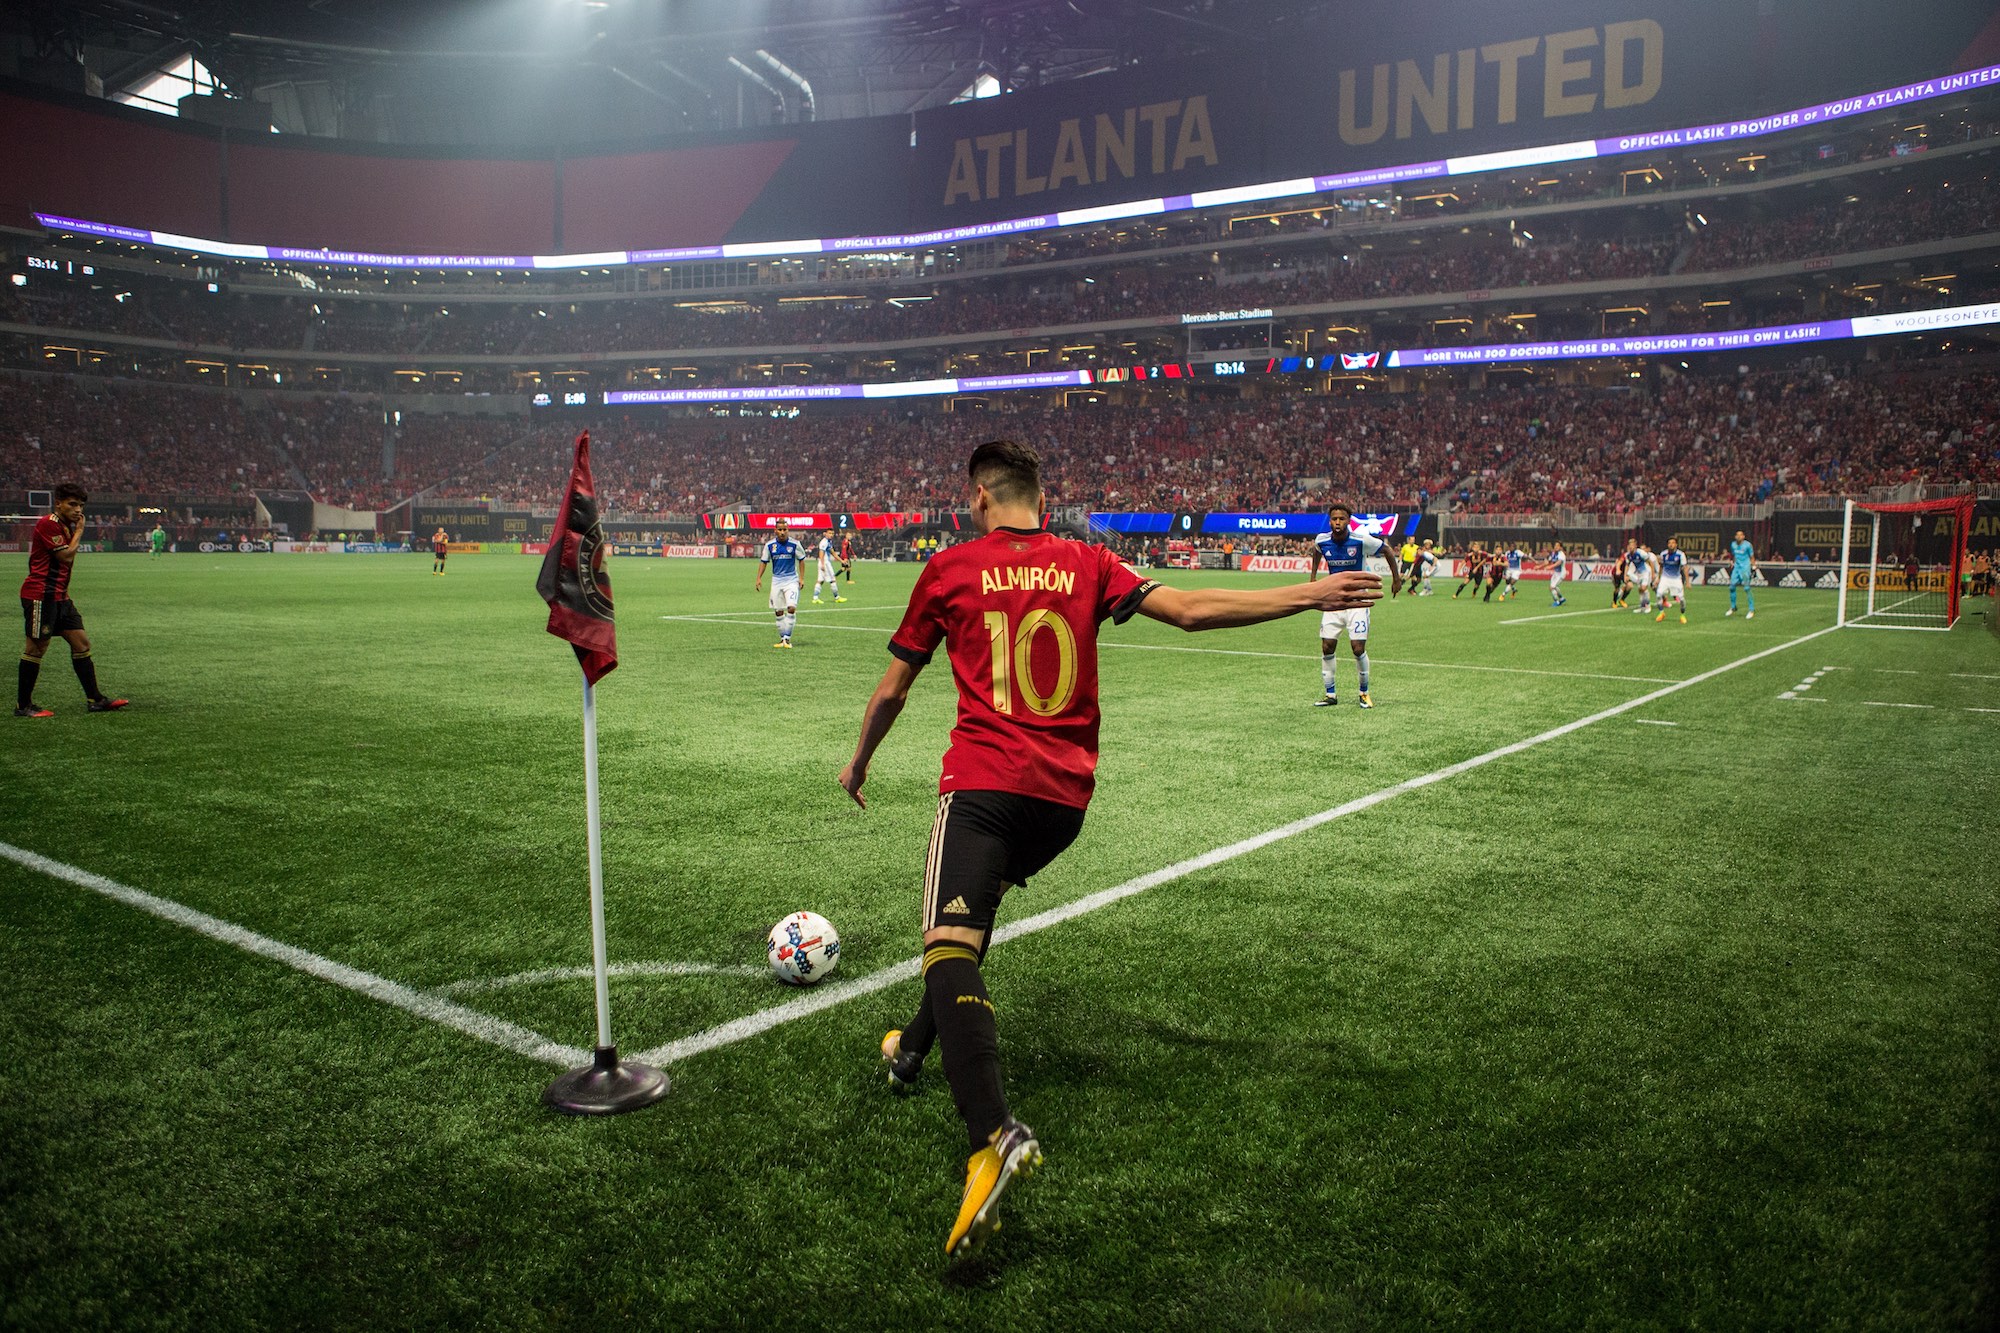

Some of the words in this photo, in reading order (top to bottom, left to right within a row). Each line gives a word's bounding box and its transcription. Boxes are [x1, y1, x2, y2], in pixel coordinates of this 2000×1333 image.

[1338, 19, 1664, 145] UNITED
[1620, 133, 1681, 150] OFFICIAL
[1686, 126, 1725, 142] LASIK
[1730, 113, 1798, 136] PROVIDER
[1824, 99, 1862, 117] YOUR
[1866, 84, 1934, 108] ATLANTA
[1940, 68, 2000, 91] UNITED
[944, 95, 1218, 205] ATLANTA
[834, 238, 874, 248] OFFICIAL
[876, 237, 901, 246] LASIK
[904, 232, 942, 244] PROVIDER
[955, 228, 976, 237] YOUR
[977, 223, 1013, 234] ATLANTA
[1015, 218, 1046, 229] UNITED
[27, 256, 59, 270] 53:14
[282, 249, 326, 260] OFFICIAL
[329, 253, 355, 262] LASIK
[358, 254, 403, 264] PROVIDER
[418, 257, 441, 265] YOUR
[443, 257, 480, 265] ATLANTA
[483, 257, 515, 265] UNITED
[1182, 311, 1238, 324] Mercedes-Benz
[1239, 308, 1273, 318] Stadium
[1894, 309, 1998, 327] WOOLFSONEYE
[1424, 352, 1451, 361] MORE
[1454, 351, 1481, 359] THAN
[1510, 346, 1558, 357] DOCTORS
[1562, 344, 1597, 354] CHOSE
[1601, 343, 1620, 352] DR.
[1624, 340, 1686, 350] WOOLFSON
[1691, 338, 1714, 347] FOR
[1718, 335, 1749, 346] THEIR
[1754, 331, 1780, 342] OWN
[1784, 327, 1820, 339] LASIK!
[1151, 367, 1158, 378] 2
[1215, 362, 1246, 374] 53:14
[1306, 358, 1314, 368] 0
[622, 393, 659, 401] OFFICIAL
[661, 392, 684, 400] LASIK
[686, 390, 728, 399] PROVIDER
[742, 390, 766, 398] YOUR
[768, 389, 806, 397] ATLANTA
[808, 388, 841, 396] UNITED
[461, 514, 489, 525] UNITE
[766, 517, 792, 526] ATLTA
[792, 517, 814, 526] UNITED
[840, 515, 846, 528] 2
[1182, 515, 1191, 530] 0
[1239, 518, 1251, 528] FC
[1252, 518, 1287, 529] DALLAS
[668, 546, 714, 556] ADVOCARE
[1678, 538, 1715, 551] UNITE
[981, 562, 1075, 595] ALMIRÓN
[1355, 621, 1366, 633] 23
[984, 608, 1078, 716] 10
[943, 906, 970, 915] adidas
